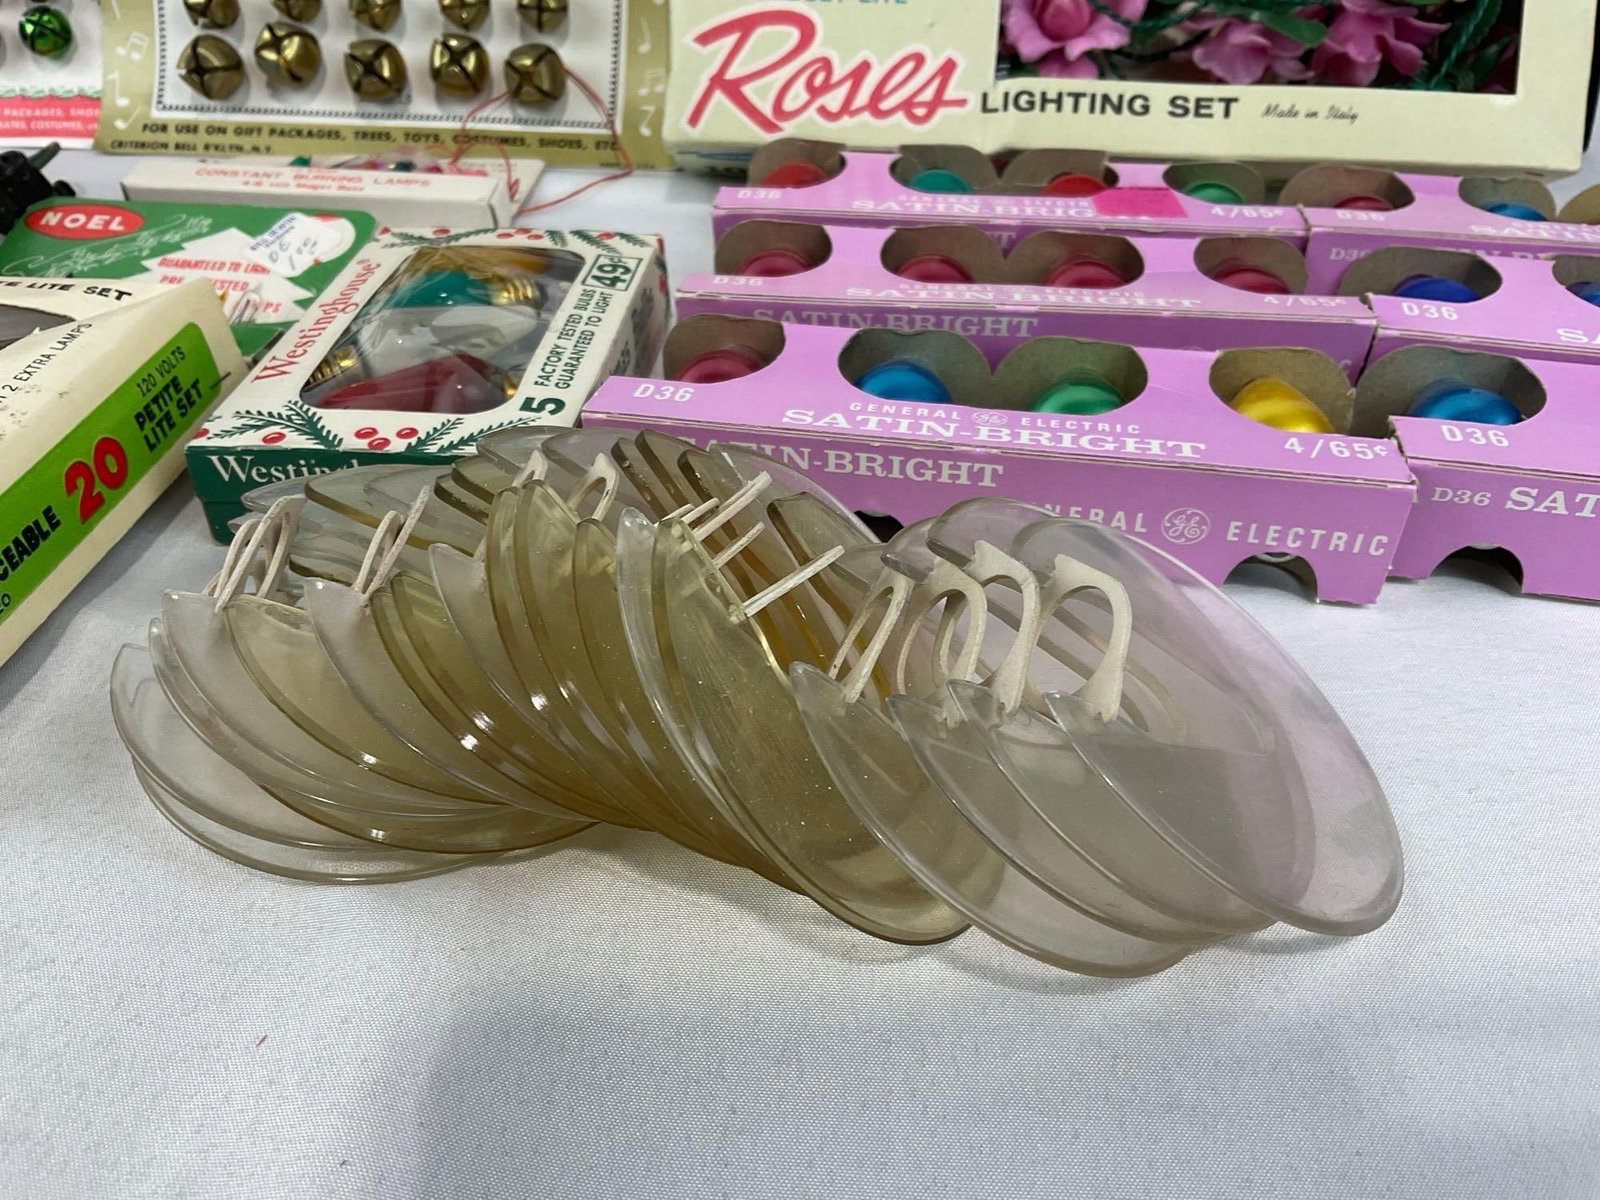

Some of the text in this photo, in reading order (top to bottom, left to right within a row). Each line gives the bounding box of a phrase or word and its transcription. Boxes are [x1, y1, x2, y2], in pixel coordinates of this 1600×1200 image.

[686, 9, 968, 135] Roses
[981, 90, 1239, 119] LIGHTING SET
[110, 140, 169, 149] CRITERION
[142, 123, 168, 134] FOR
[175, 124, 198, 134] USE
[205, 125, 227, 136] ON
[234, 126, 262, 137] GIFT
[269, 127, 346, 141] PACKAGES,
[354, 131, 397, 143] TREES,
[538, 138, 588, 150] SHOES,
[195, 167, 283, 179] CONSTANT
[736, 190, 782, 200] D36
[852, 200, 1098, 217] SATIN-BRIG
[39, 211, 126, 232] NOEL
[157, 257, 226, 272] GUARANTEED
[227, 261, 242, 272] TO
[590, 256, 632, 289] 49¢
[26, 282, 76, 292] LITE
[82, 285, 133, 302] SET
[711, 275, 766, 287] D36
[845, 288, 1203, 308] SATIN-BRIGHT
[1401, 301, 1460, 321] D36
[252, 260, 383, 385] Westinghouse
[13, 353, 57, 382] EXTRA
[49, 322, 93, 352] LAMPS
[534, 288, 597, 387] FACTORY TESTED BULBS
[554, 291, 614, 390] GUARANTEED TO LIGHT
[136, 345, 186, 398] 120 VOLTS
[133, 375, 184, 432] PETITE
[518, 396, 567, 417] 5
[632, 383, 695, 403] D36
[143, 377, 203, 454] LITE SET
[848, 401, 962, 421] GENERAL
[1019, 416, 1142, 435] ELECTRIC
[780, 408, 1207, 459] SATIN-BRIGHT
[1283, 435, 1389, 461] 4/65¢
[1440, 424, 1510, 448] D36
[64, 436, 129, 526] 20
[206, 455, 359, 484] Westin
[1431, 486, 1600, 518] D36 SAT
[1042, 503, 1147, 533] ERAL
[1226, 520, 1389, 556] ELECTRIC
